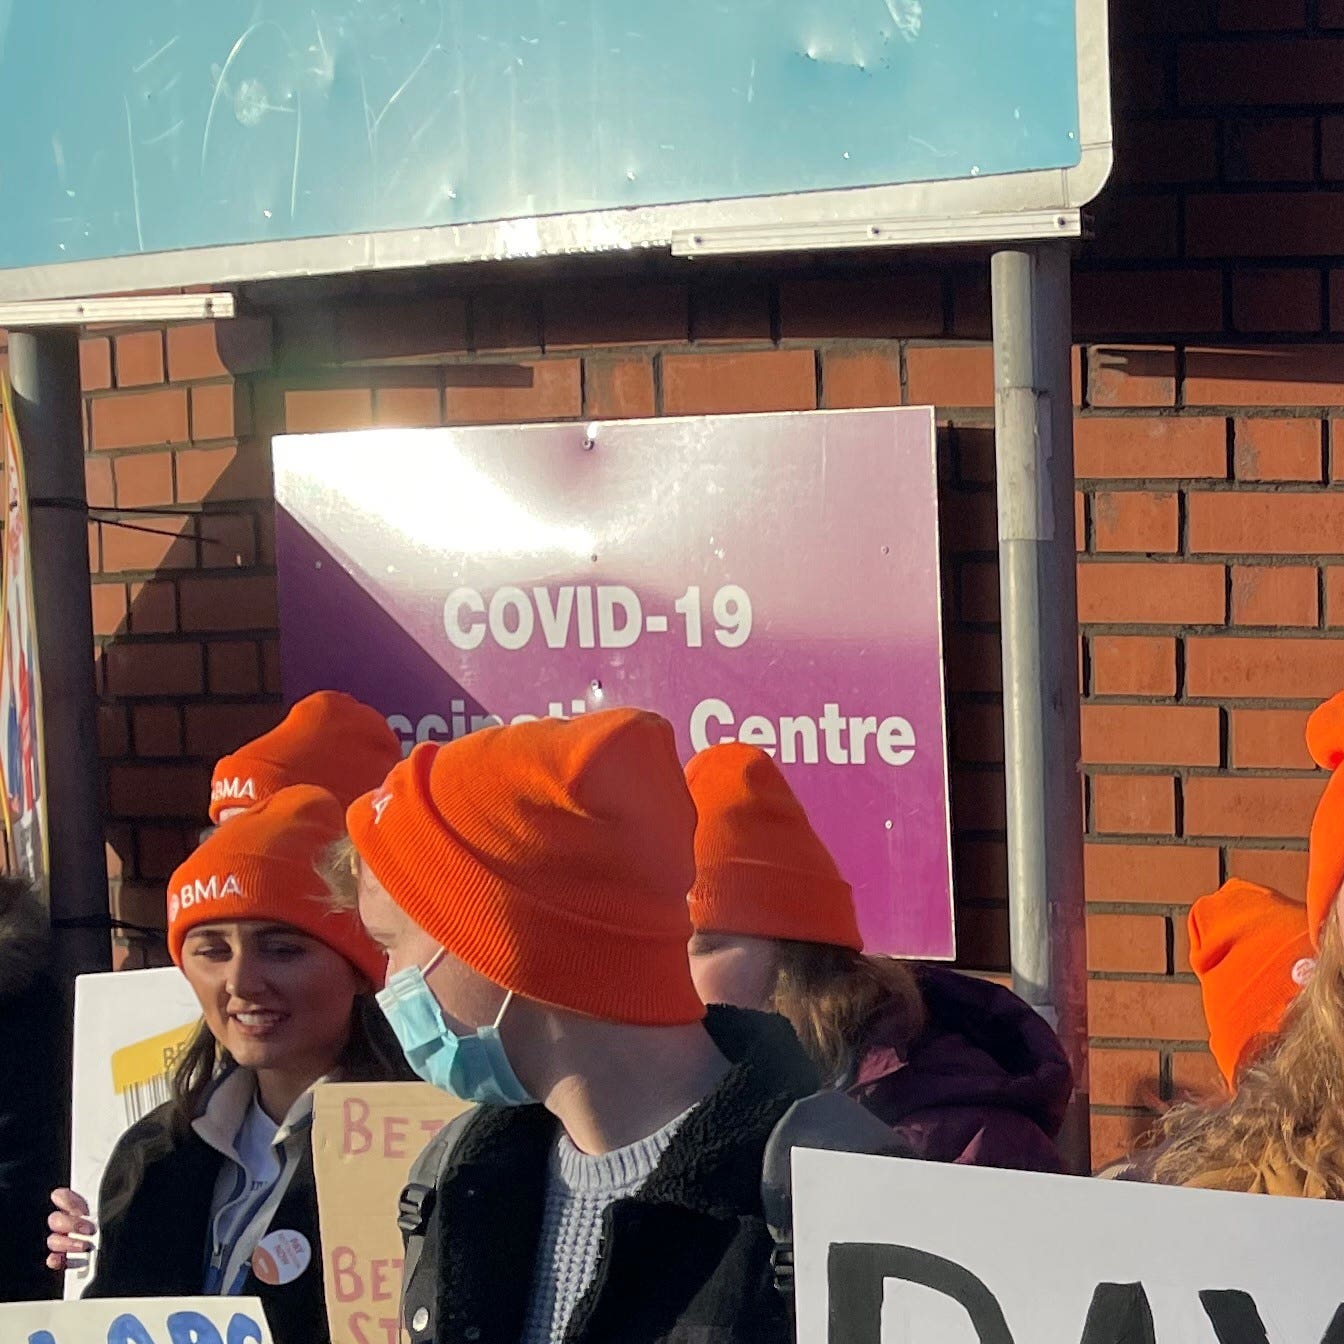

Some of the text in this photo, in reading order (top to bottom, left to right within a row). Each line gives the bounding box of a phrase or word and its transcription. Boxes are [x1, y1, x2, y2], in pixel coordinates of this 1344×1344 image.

[443, 584, 753, 651] COVID-19
[689, 697, 916, 766] Centre
[181, 873, 242, 909] BMA
